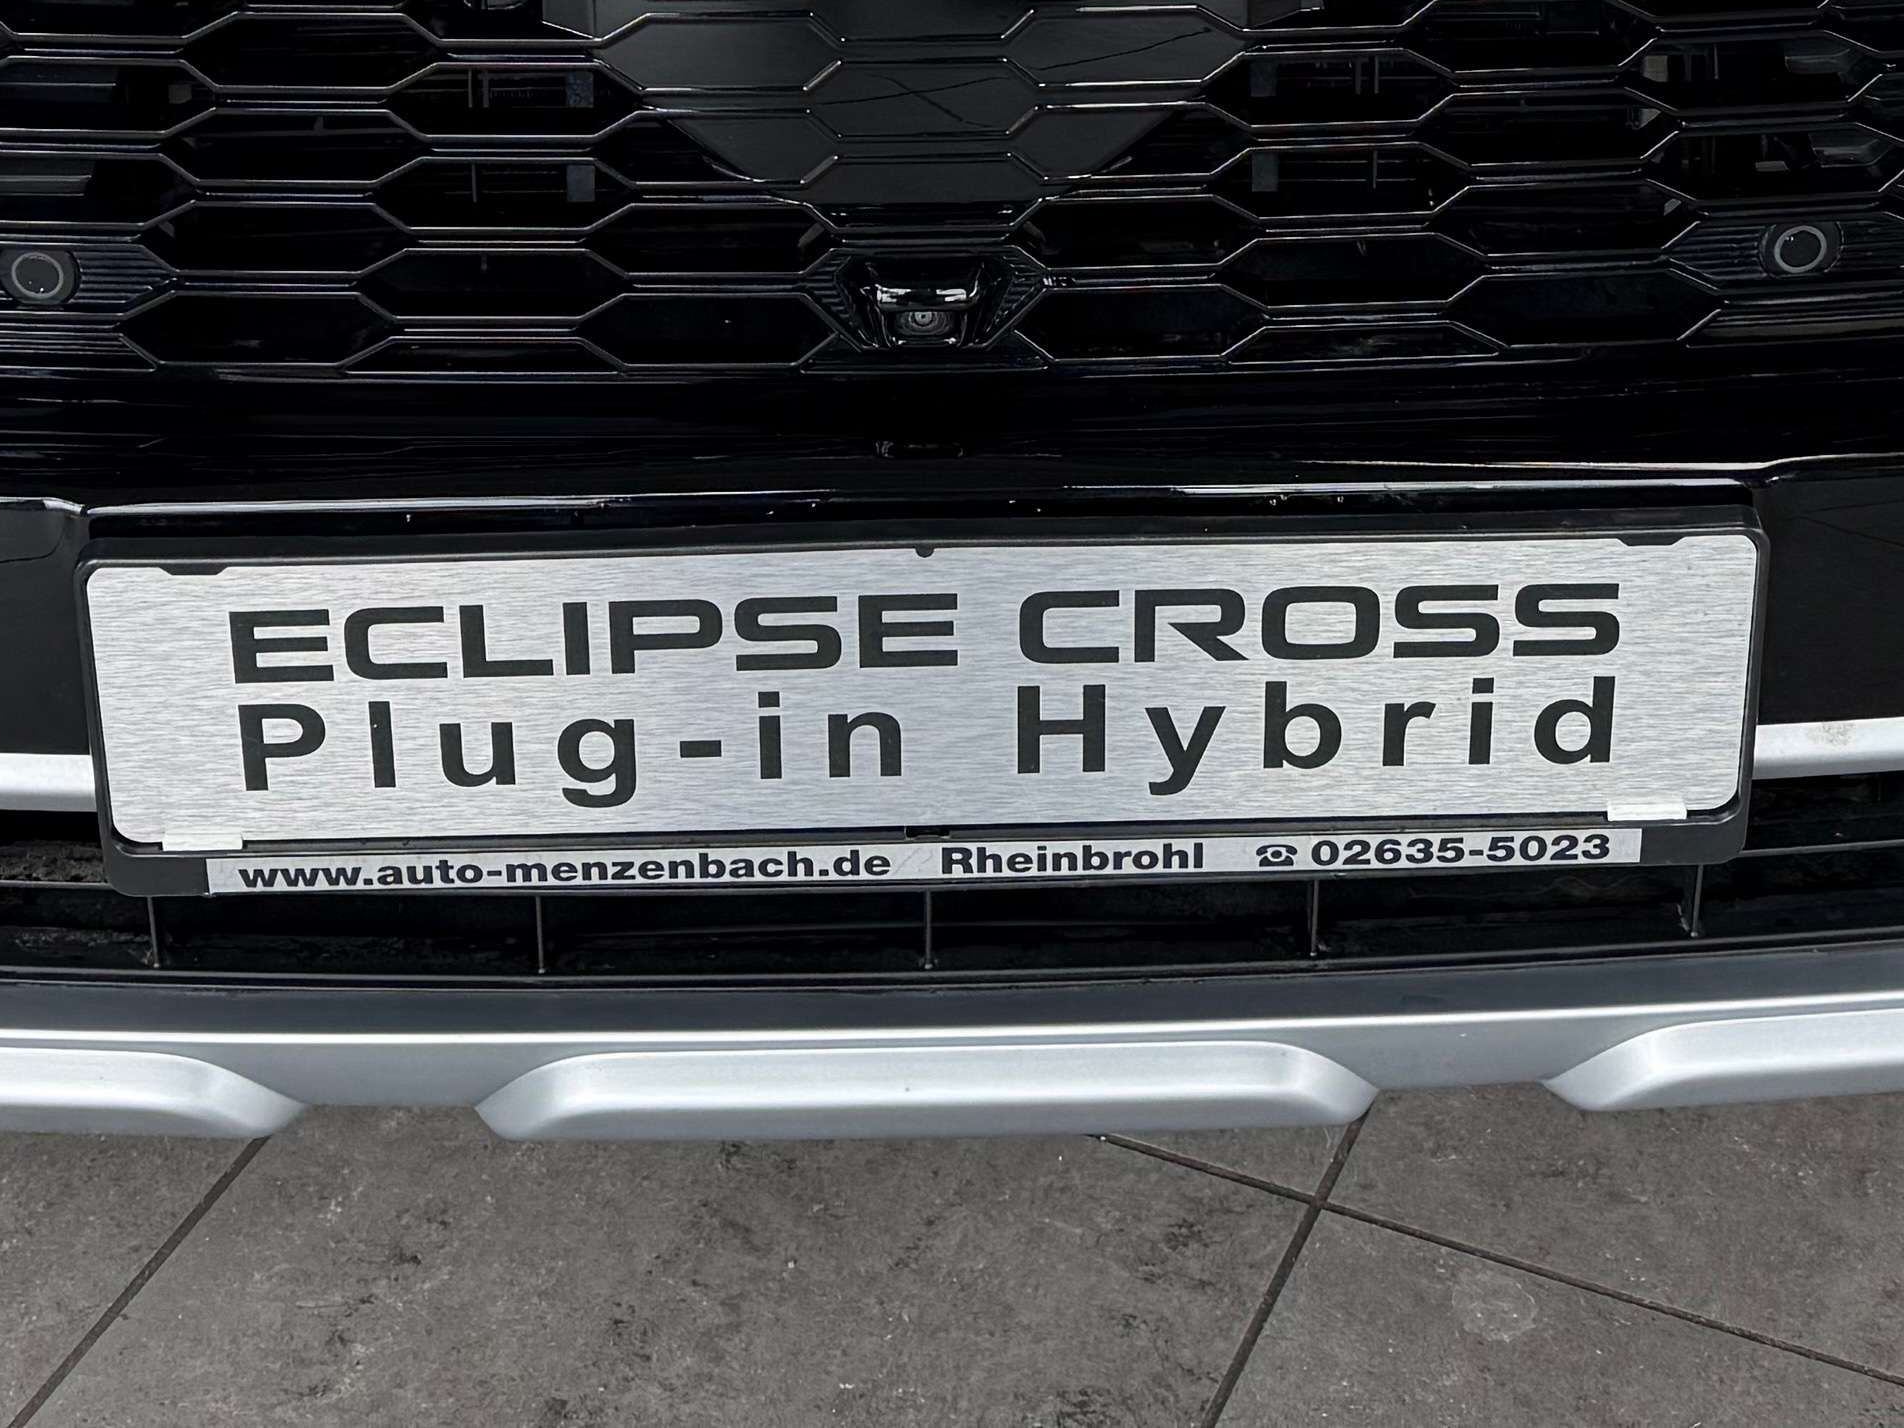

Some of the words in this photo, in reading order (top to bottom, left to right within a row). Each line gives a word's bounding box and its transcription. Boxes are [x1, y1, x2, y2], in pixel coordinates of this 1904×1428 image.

[228, 592, 959, 684] ECLIPSE
[1018, 582, 1621, 664] CROSS
[237, 690, 903, 808] Plug-in
[1016, 675, 1617, 797] Hybrid
[238, 849, 892, 889] www.auto-menzenbach.de
[940, 842, 1205, 876] Rheinbrohl
[1311, 833, 1611, 867] 02635-5023
